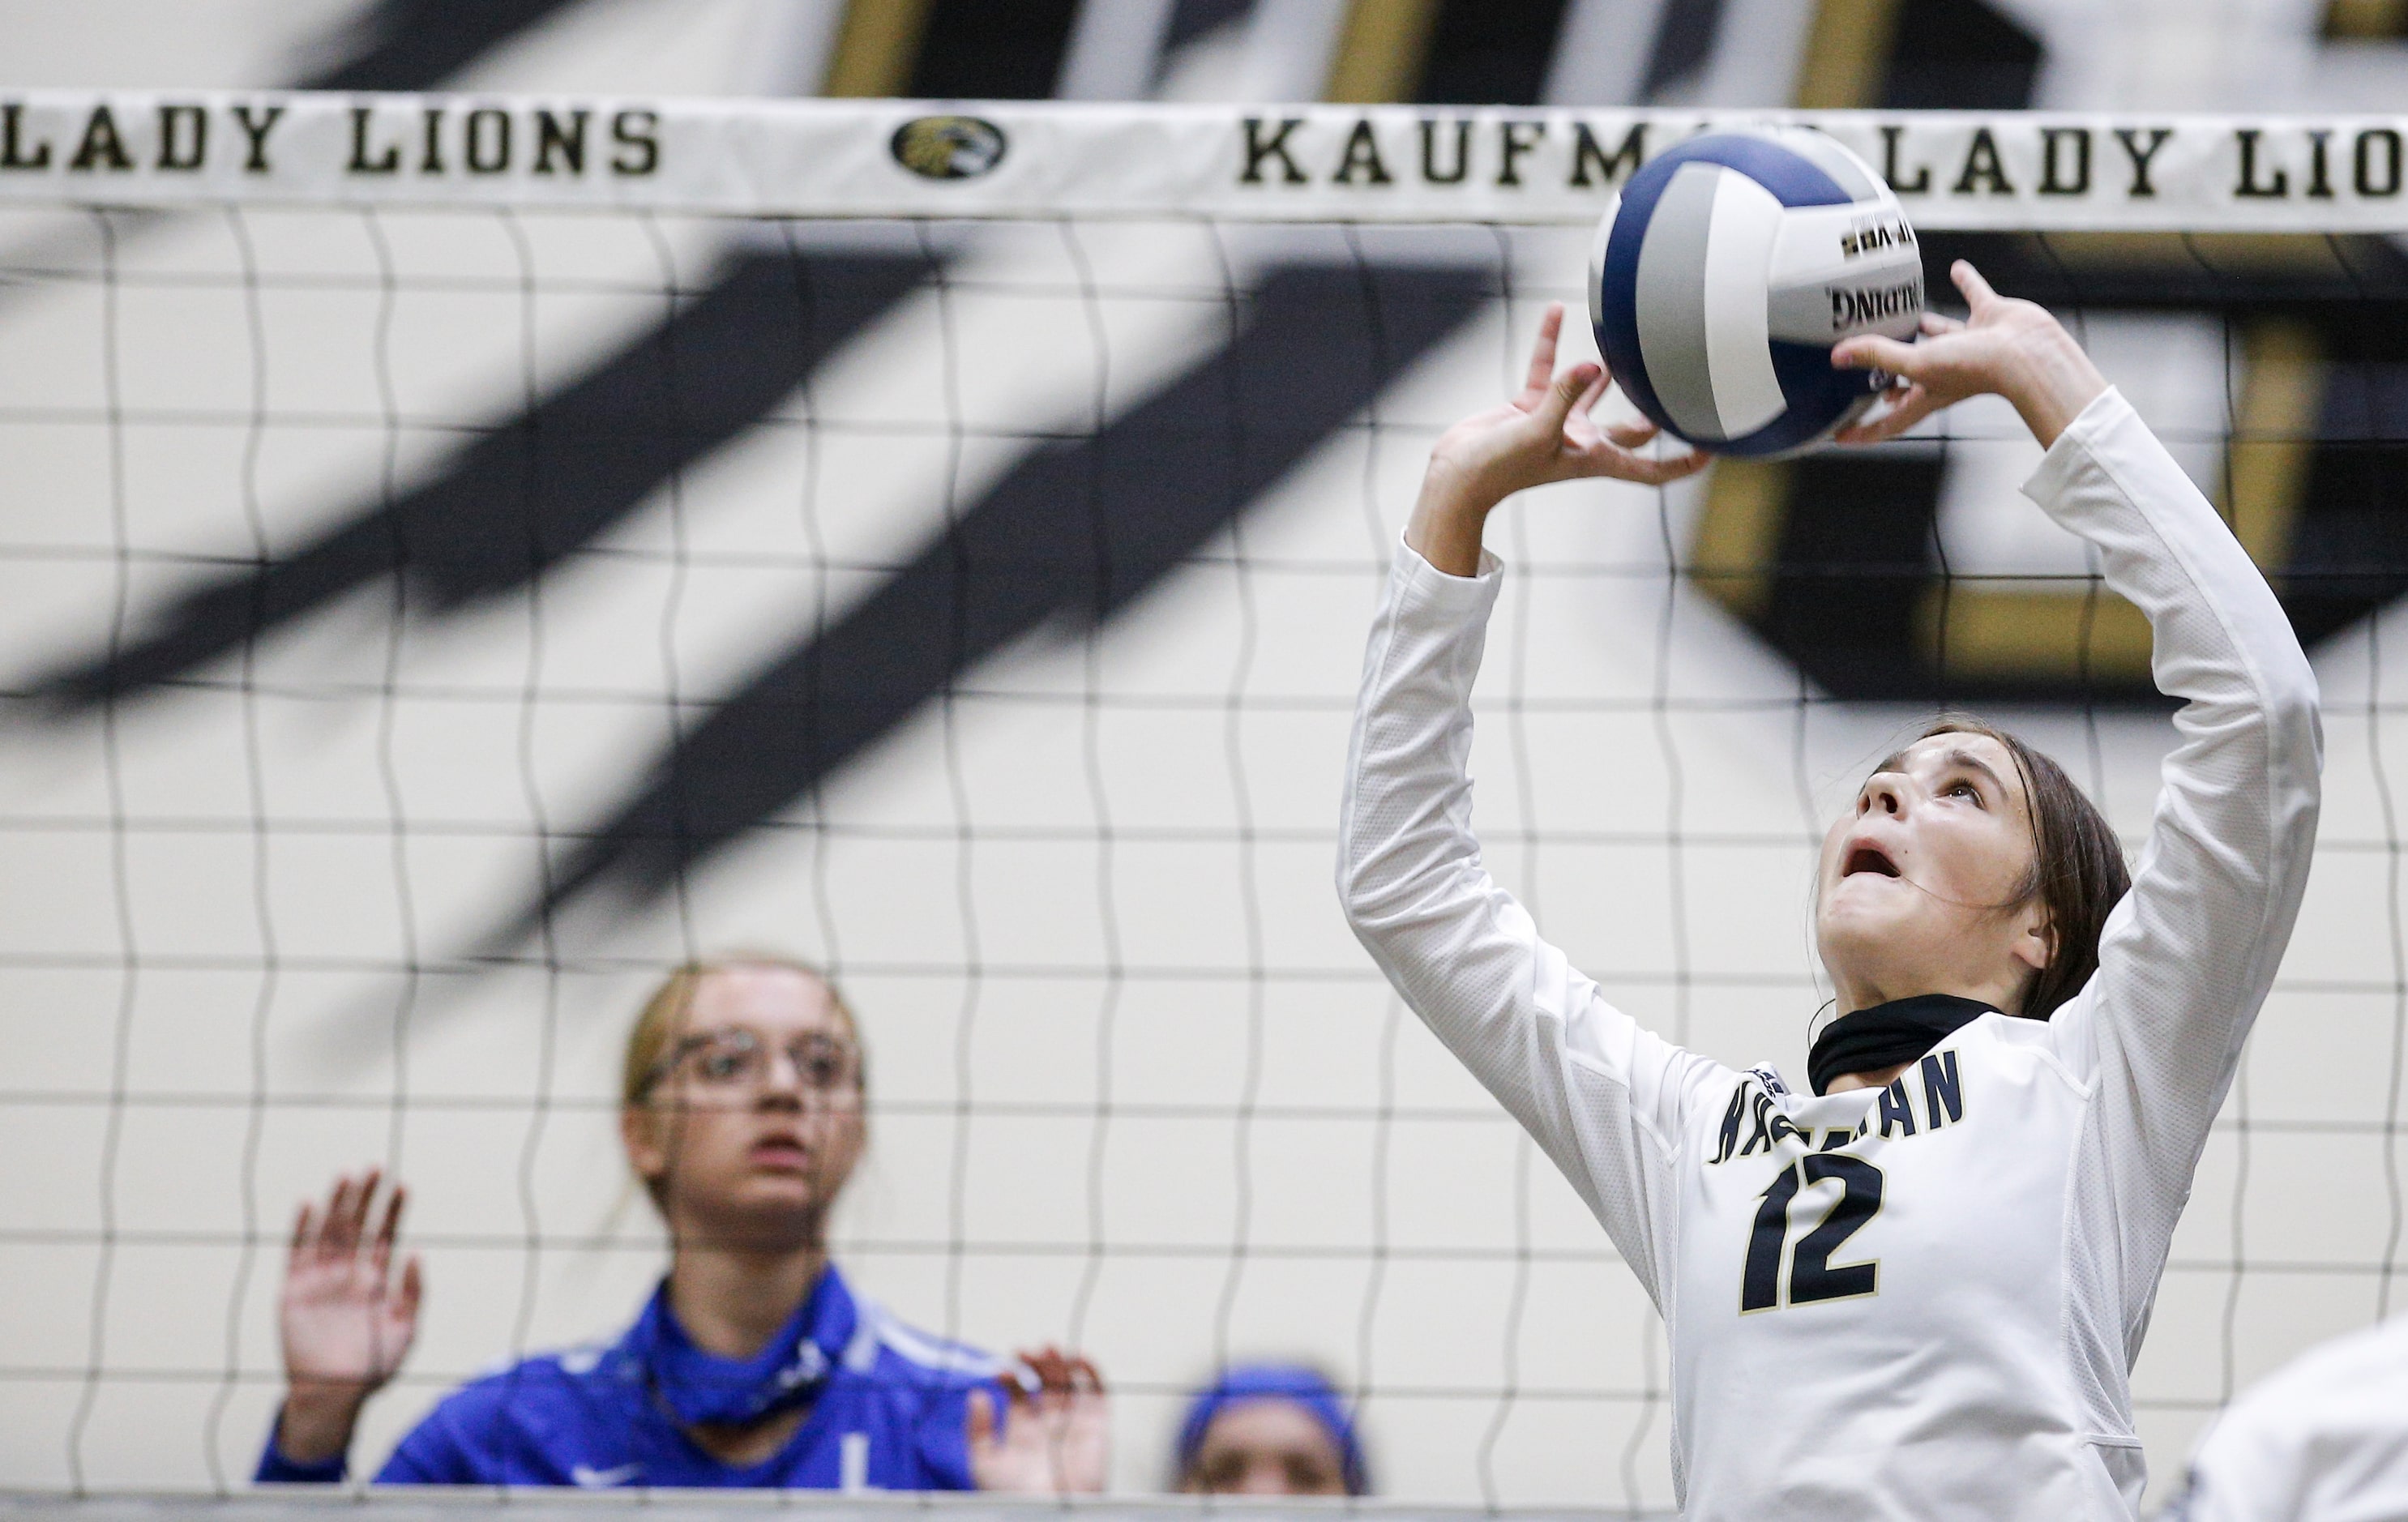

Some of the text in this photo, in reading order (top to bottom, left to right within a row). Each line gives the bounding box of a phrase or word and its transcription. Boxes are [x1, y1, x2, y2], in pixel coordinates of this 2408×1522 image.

[0, 102, 663, 176] LADY LIONS
[1238, 117, 2404, 197] KAUFM LADY LIO
[1739, 1151, 1887, 1316] 12
